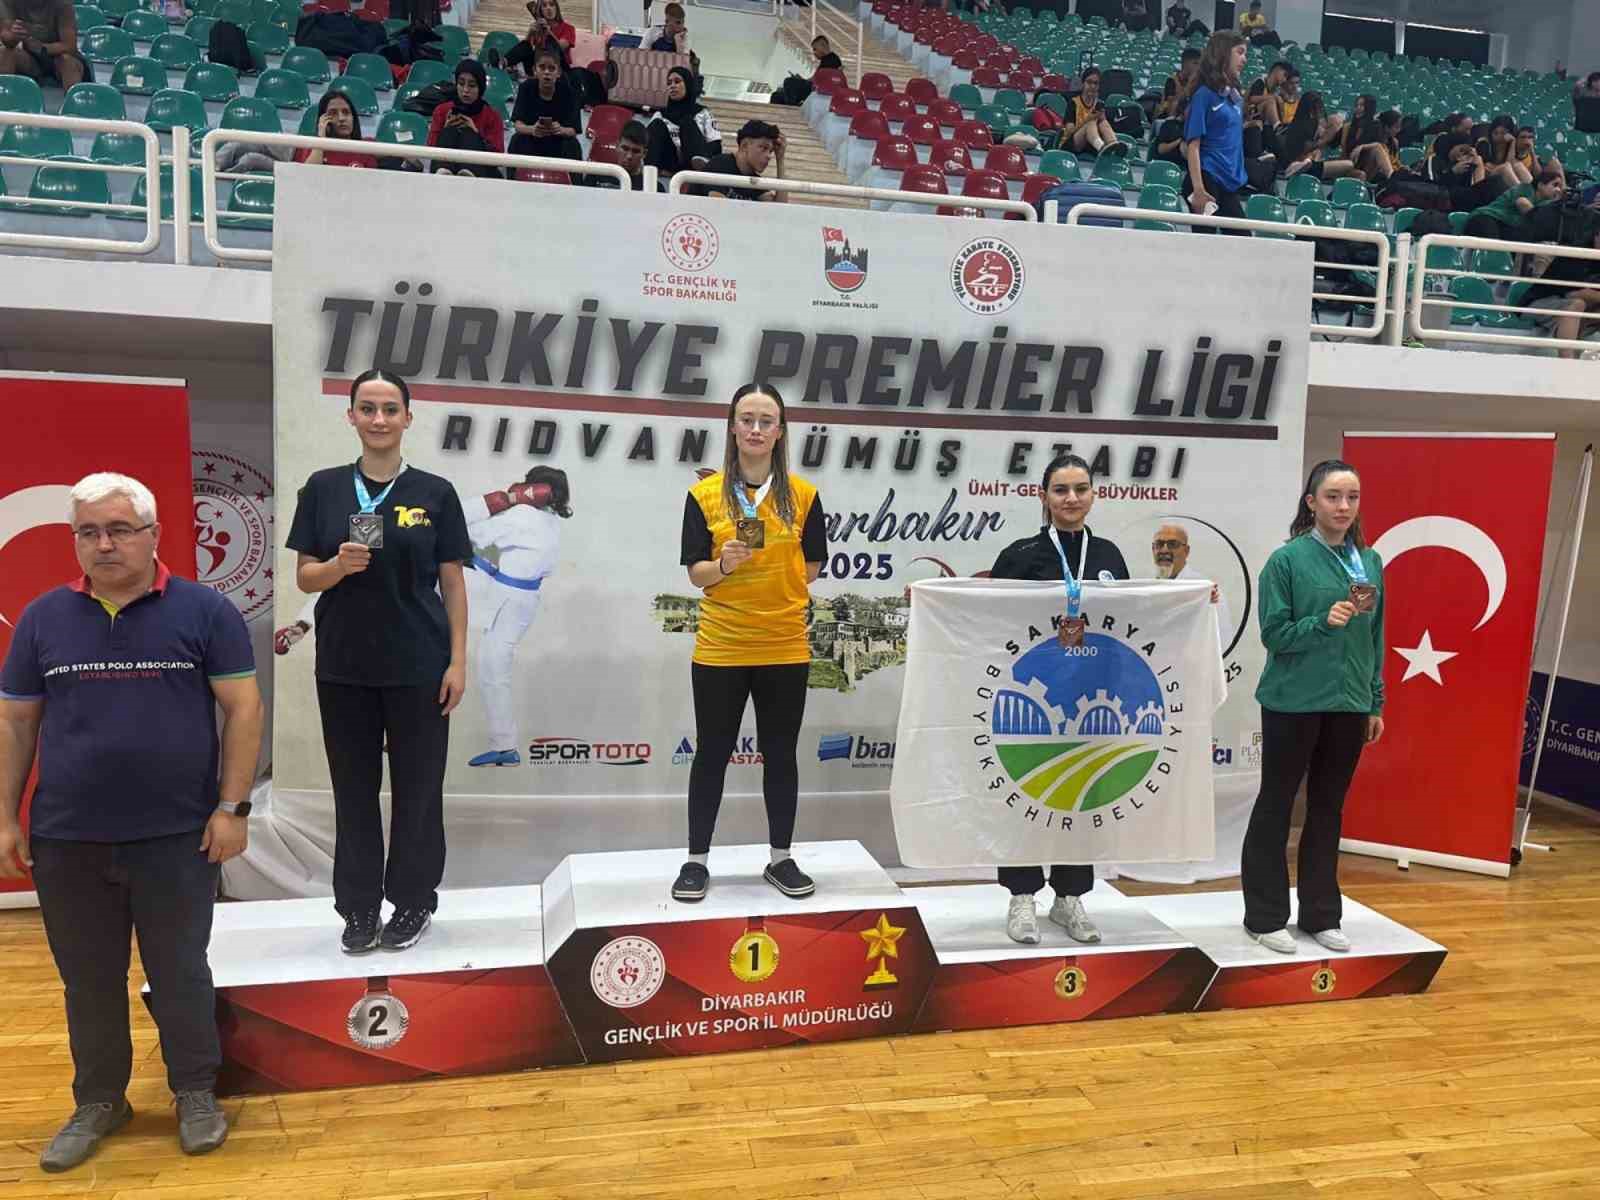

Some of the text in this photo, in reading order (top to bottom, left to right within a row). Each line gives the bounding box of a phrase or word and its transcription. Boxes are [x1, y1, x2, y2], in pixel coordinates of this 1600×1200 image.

[642, 286, 737, 302] SPOR BAKANLIĞI
[667, 275, 718, 288] GENÇLİK
[722, 279, 737, 289] VE
[322, 282, 1282, 421] TÜRKİYE PREMİER LİGİ
[442, 414, 710, 463] RIDVAN
[801, 425, 961, 477] ÜMÜŞ
[1006, 612, 1157, 657] SAKARYA
[1064, 646, 1098, 657] 2000
[72, 663, 106, 671] STATES
[108, 662, 134, 670] POLO
[136, 661, 195, 671] ASSOCIATION
[973, 664, 1073, 831] BÜYÜKŞEHİR
[747, 942, 759, 971] 1
[1064, 972, 1076, 993] 3
[1317, 973, 1329, 990] 3
[701, 988, 806, 1012] DİYARBAKIR
[368, 1005, 388, 1037] 2
[604, 1001, 893, 1047] GENÇLİK VE SPOR İL MÜDÜRLÜĞÜ
